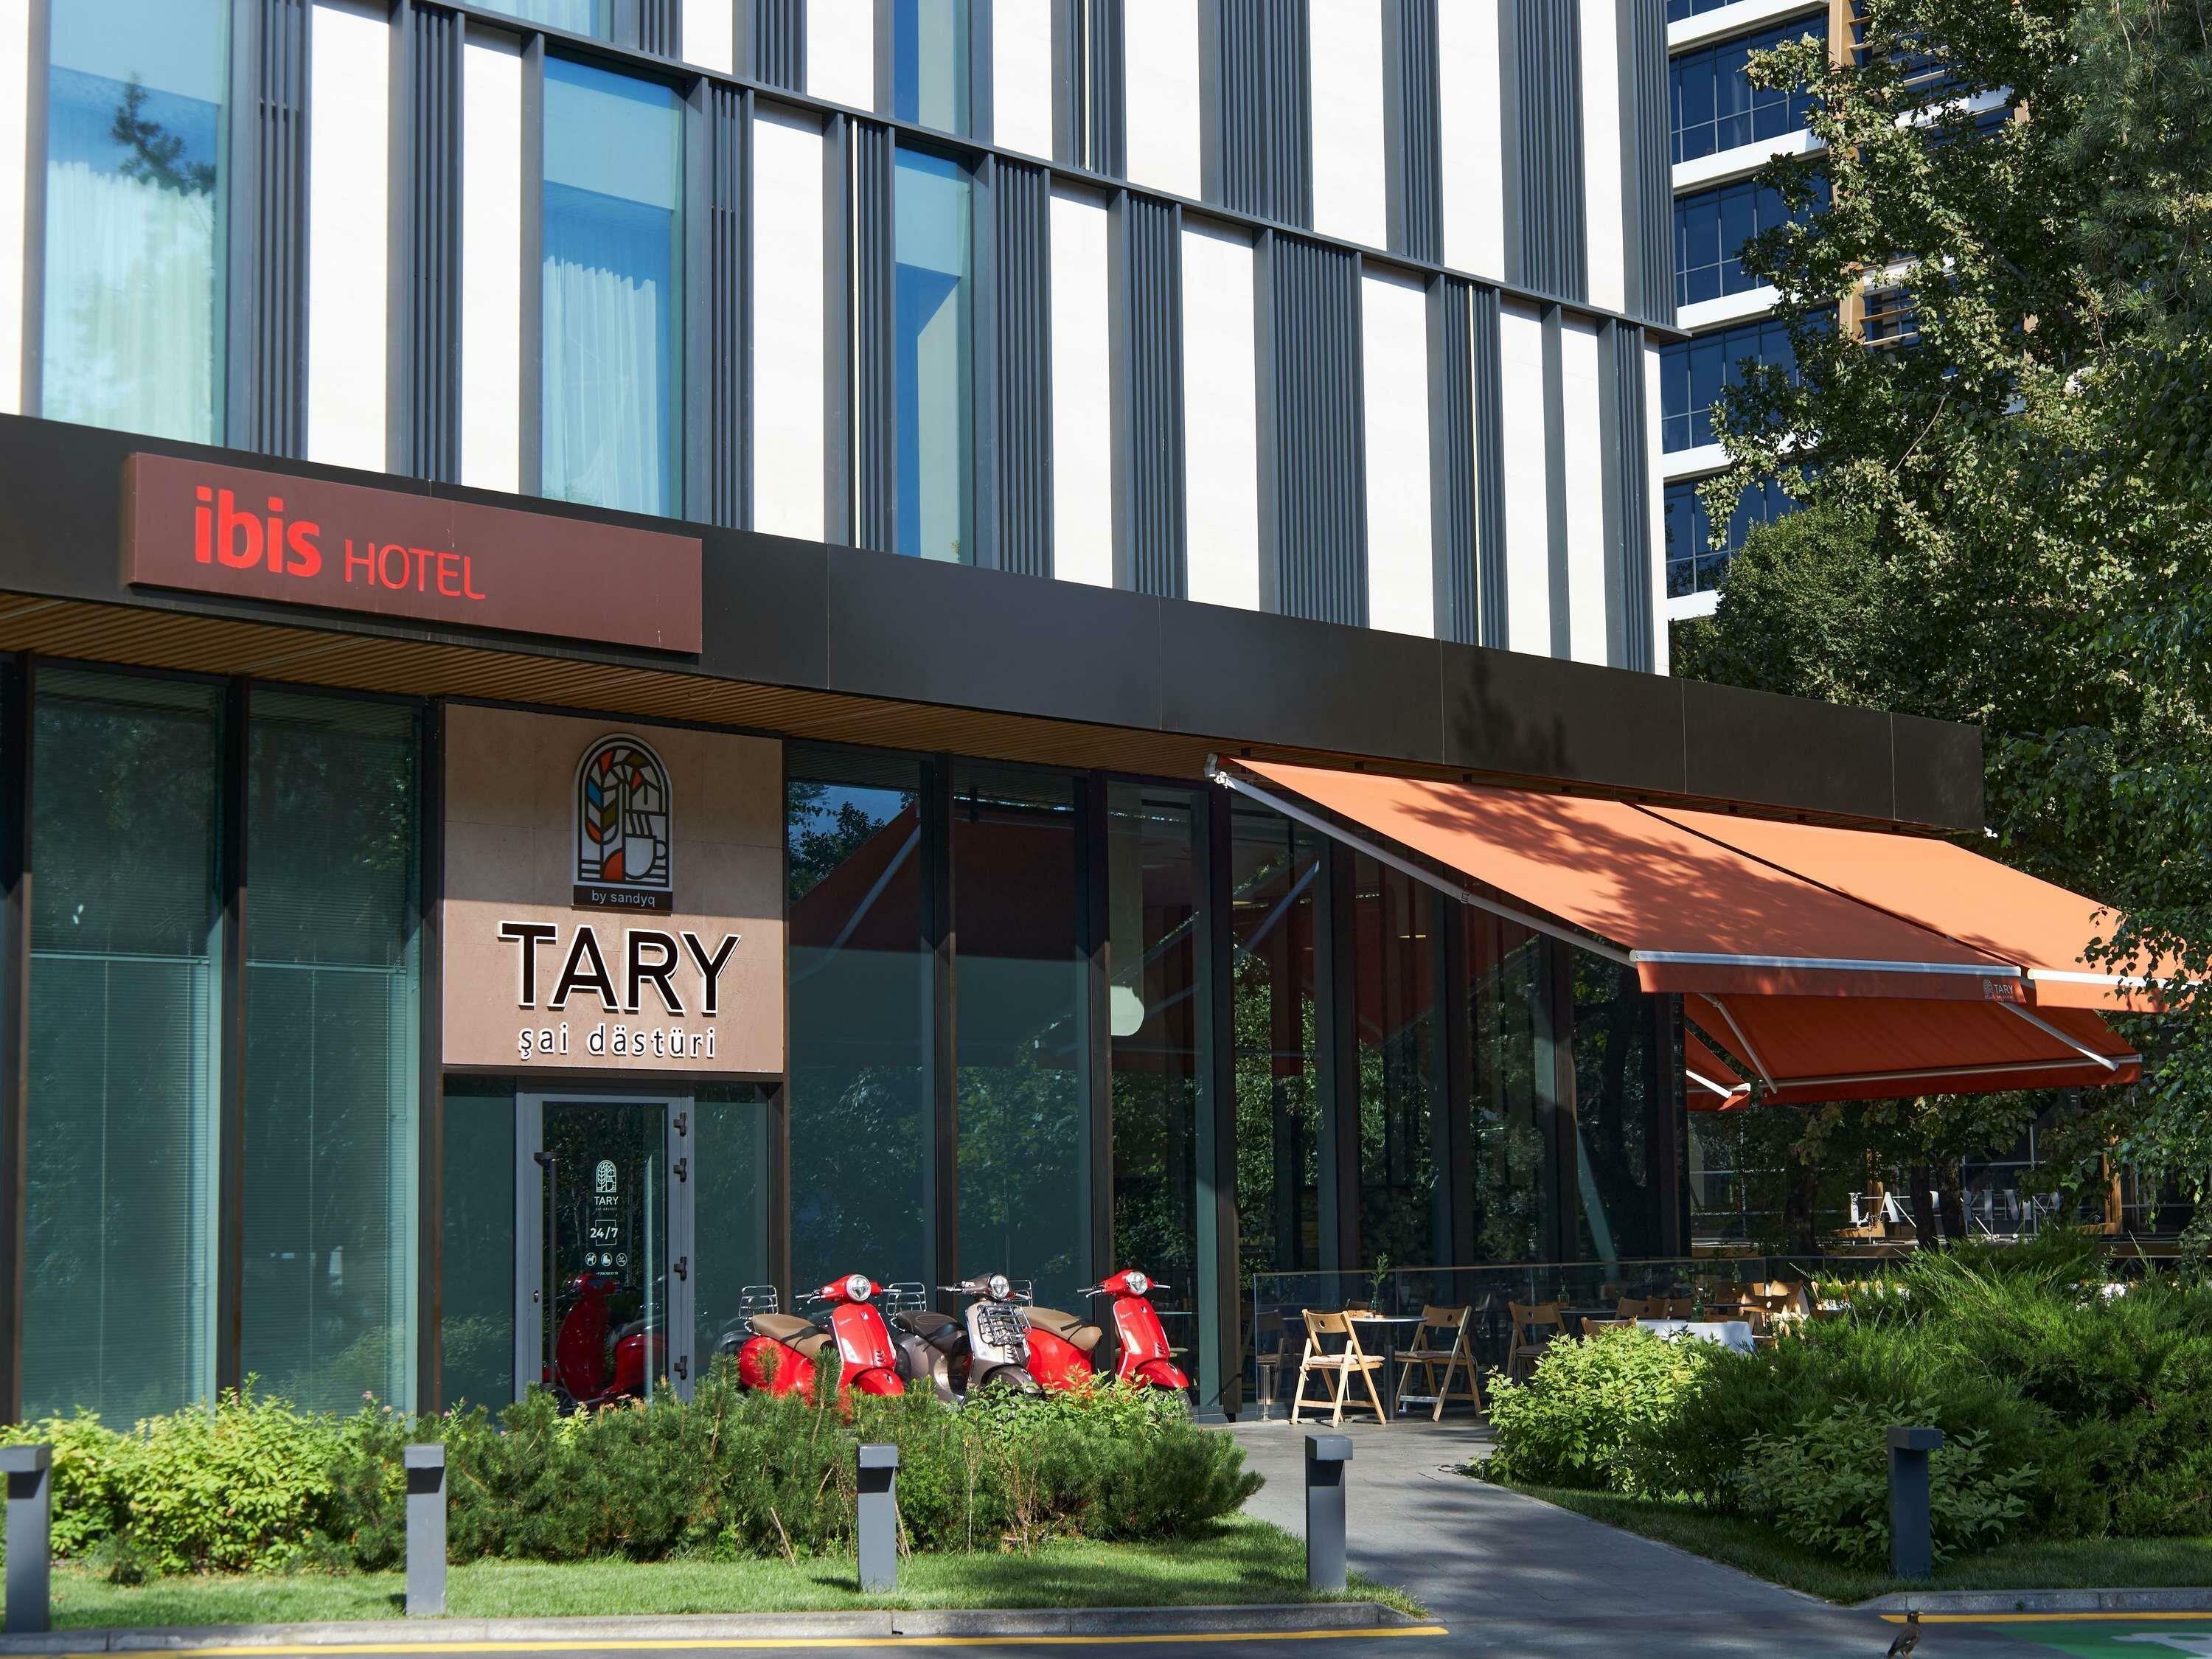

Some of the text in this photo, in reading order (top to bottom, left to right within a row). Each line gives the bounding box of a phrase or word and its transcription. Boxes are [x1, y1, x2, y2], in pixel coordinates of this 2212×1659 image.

[195, 486, 486, 600] ibis HOTEL
[591, 889, 655, 908] by sandyq
[498, 920, 742, 1018] TARY
[1993, 984, 2014, 995] TARY
[518, 1022, 715, 1059] şai dästüri
[594, 1196, 619, 1206] TARY
[1848, 1191, 1902, 1224] LA
[590, 1226, 619, 1240] 24/7
